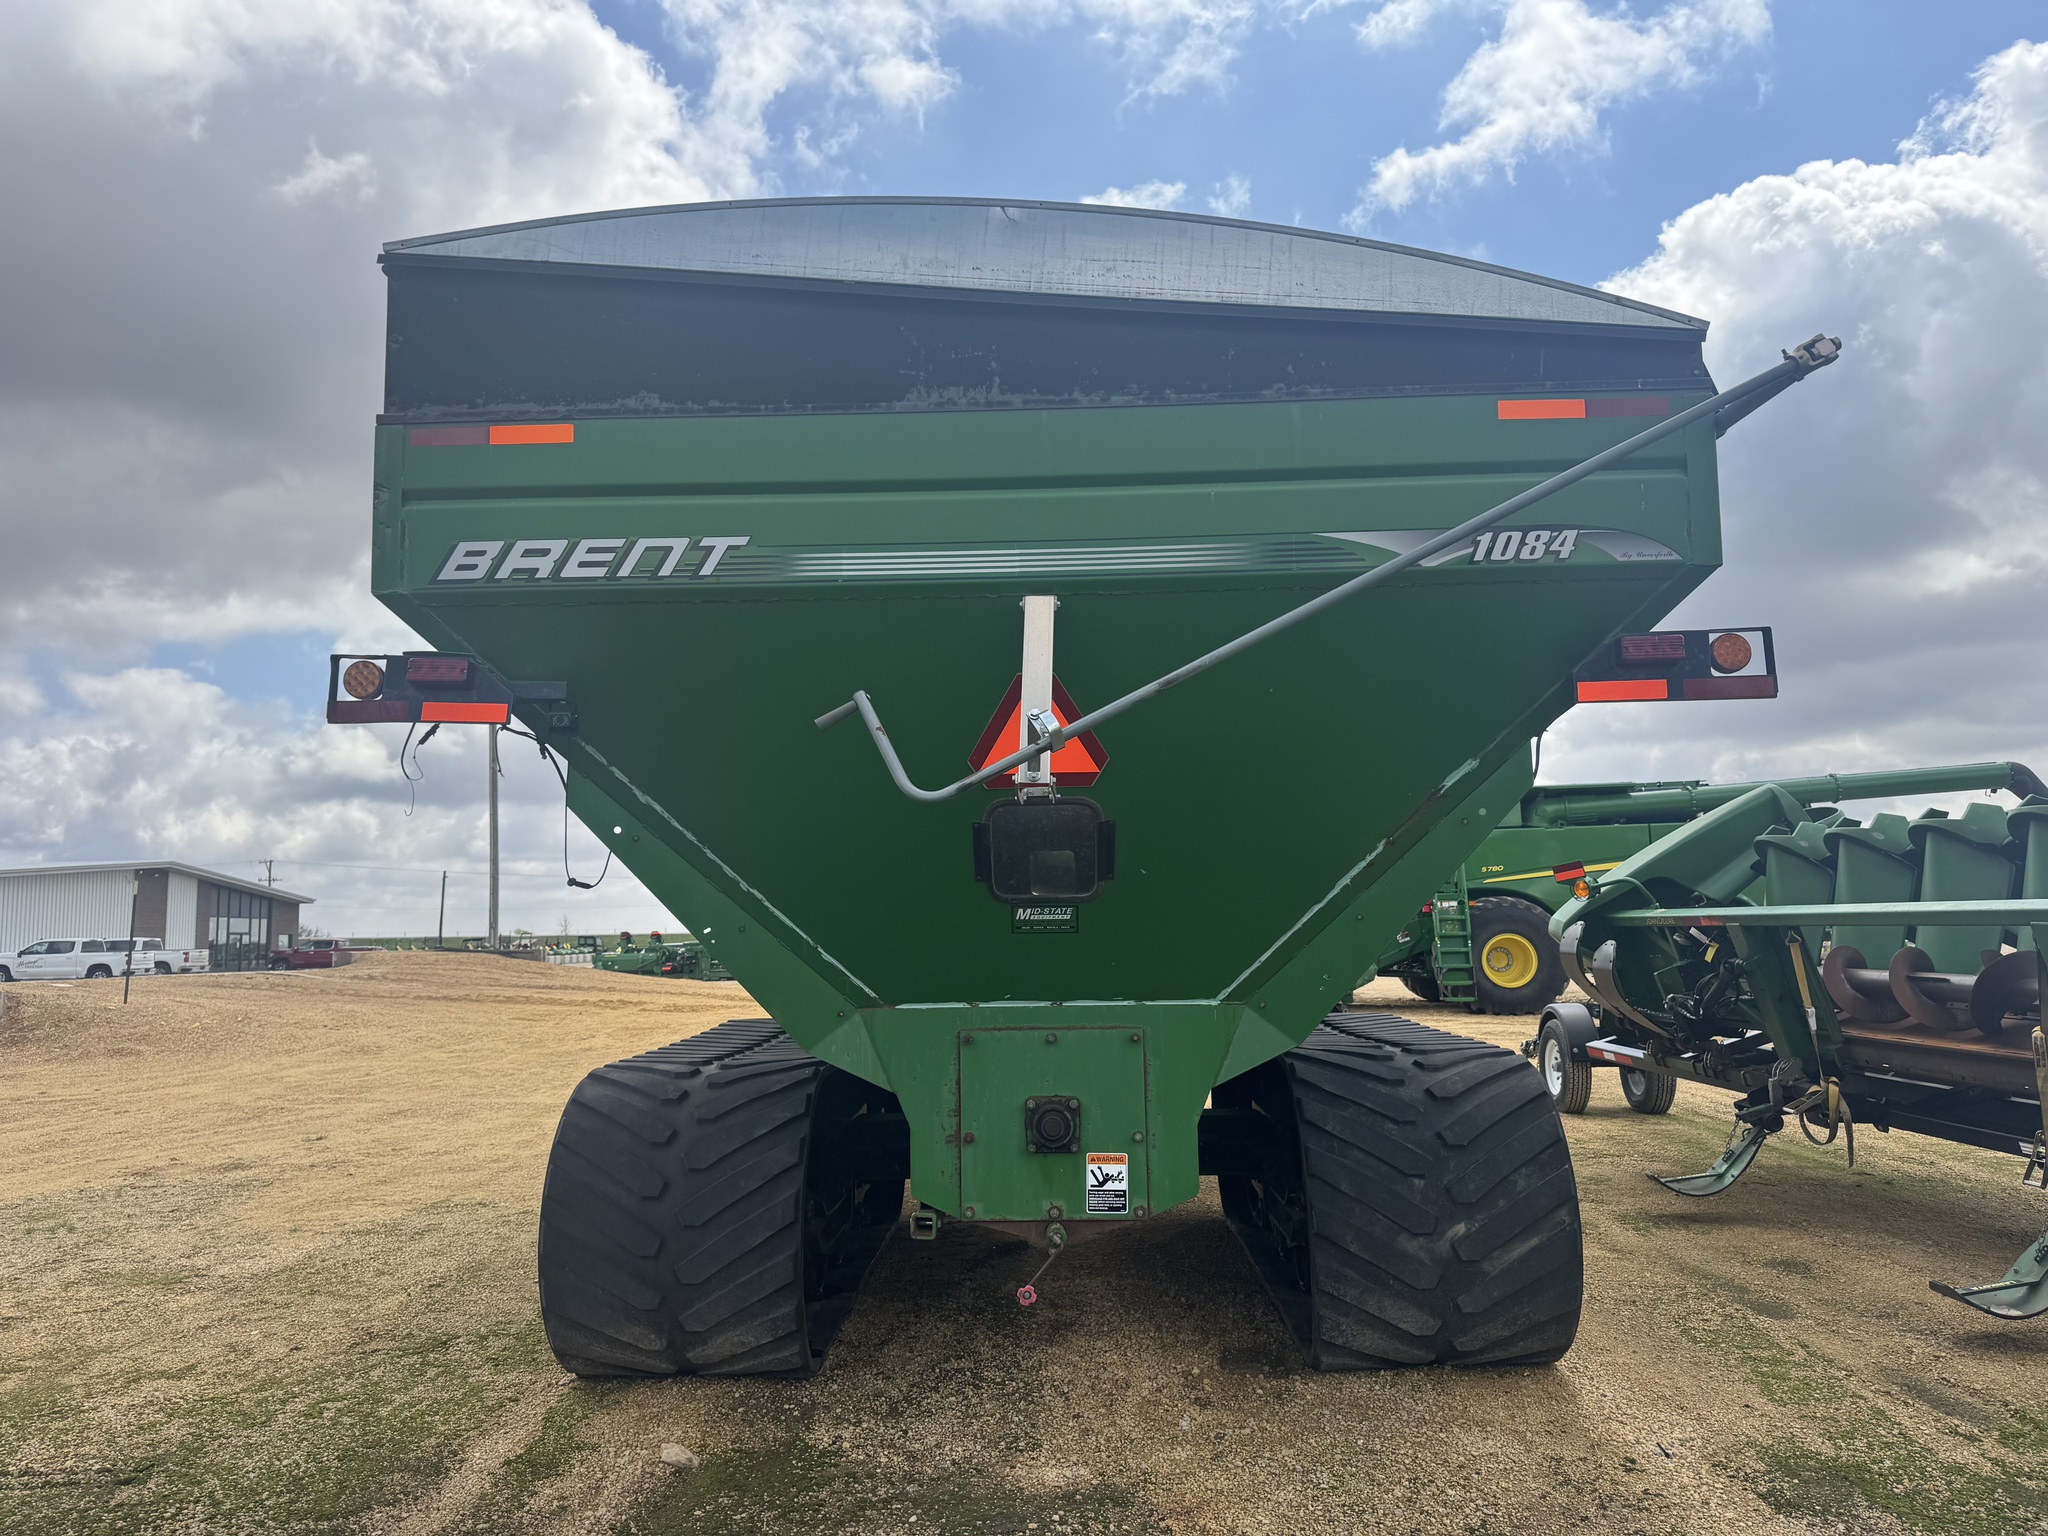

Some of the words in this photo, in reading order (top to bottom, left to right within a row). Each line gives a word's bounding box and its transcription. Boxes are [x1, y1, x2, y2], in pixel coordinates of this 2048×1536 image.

[434, 535, 752, 582] BRENT
[1473, 528, 1579, 562] 1084
[1016, 907, 1073, 920] MID-STATE
